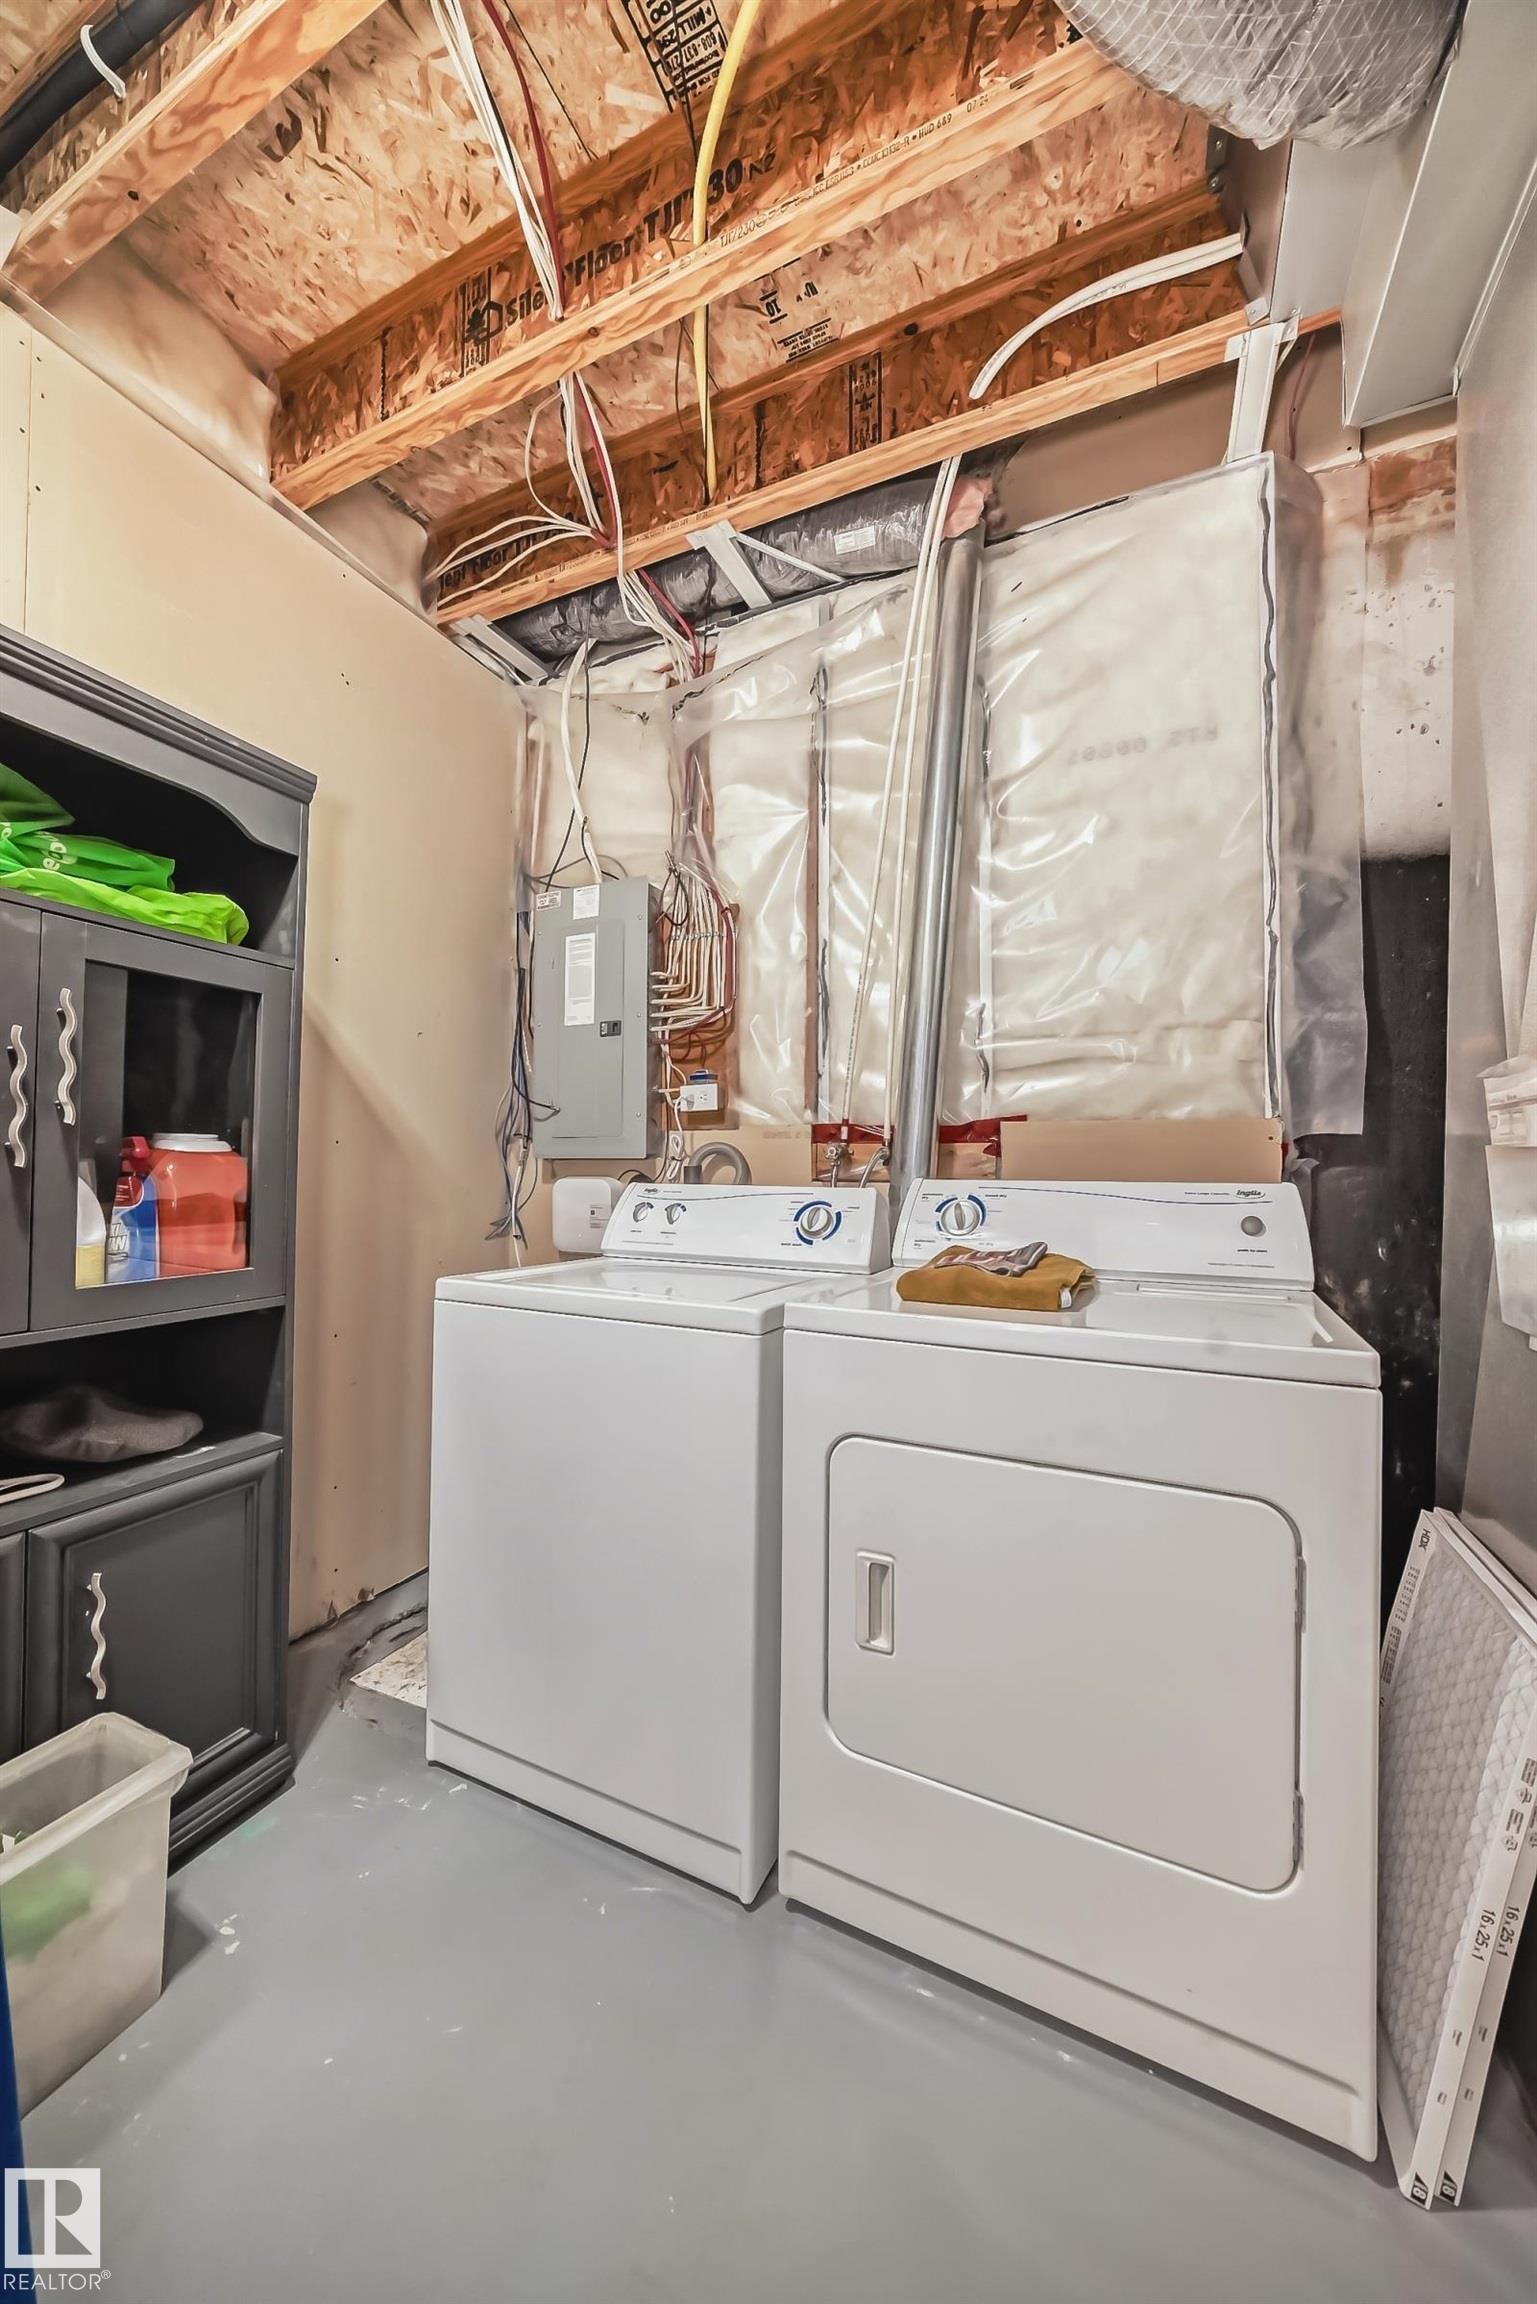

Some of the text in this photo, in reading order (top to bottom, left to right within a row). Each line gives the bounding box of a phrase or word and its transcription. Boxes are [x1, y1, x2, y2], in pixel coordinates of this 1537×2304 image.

[574, 240, 634, 287] Floor
[706, 157, 743, 205] 30
[1418, 1528, 1431, 1550] HDX
